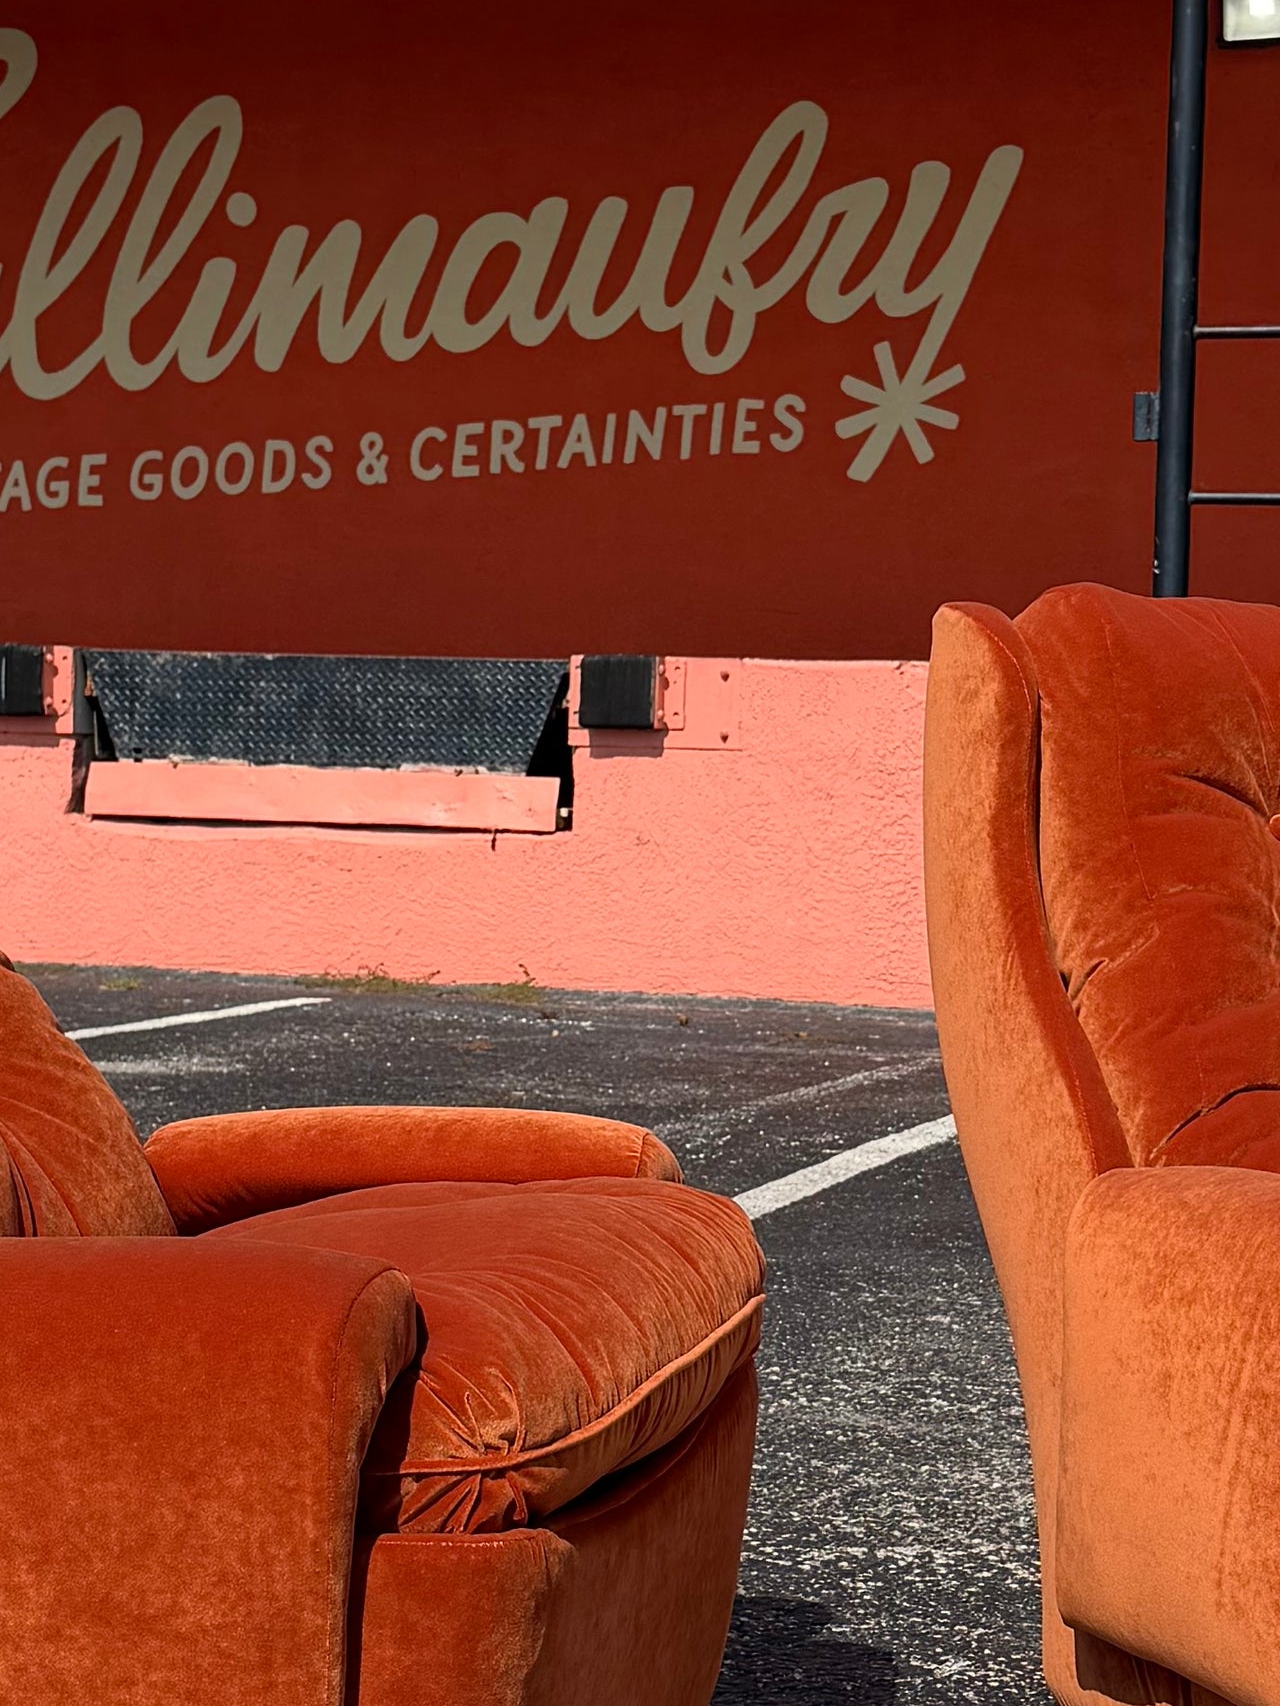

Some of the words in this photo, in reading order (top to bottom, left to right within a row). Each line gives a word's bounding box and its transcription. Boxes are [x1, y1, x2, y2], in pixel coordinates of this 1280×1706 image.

[129, 434, 334, 501] GOODS
[356, 430, 389, 486] &
[409, 392, 807, 482] CERTAINTIES
